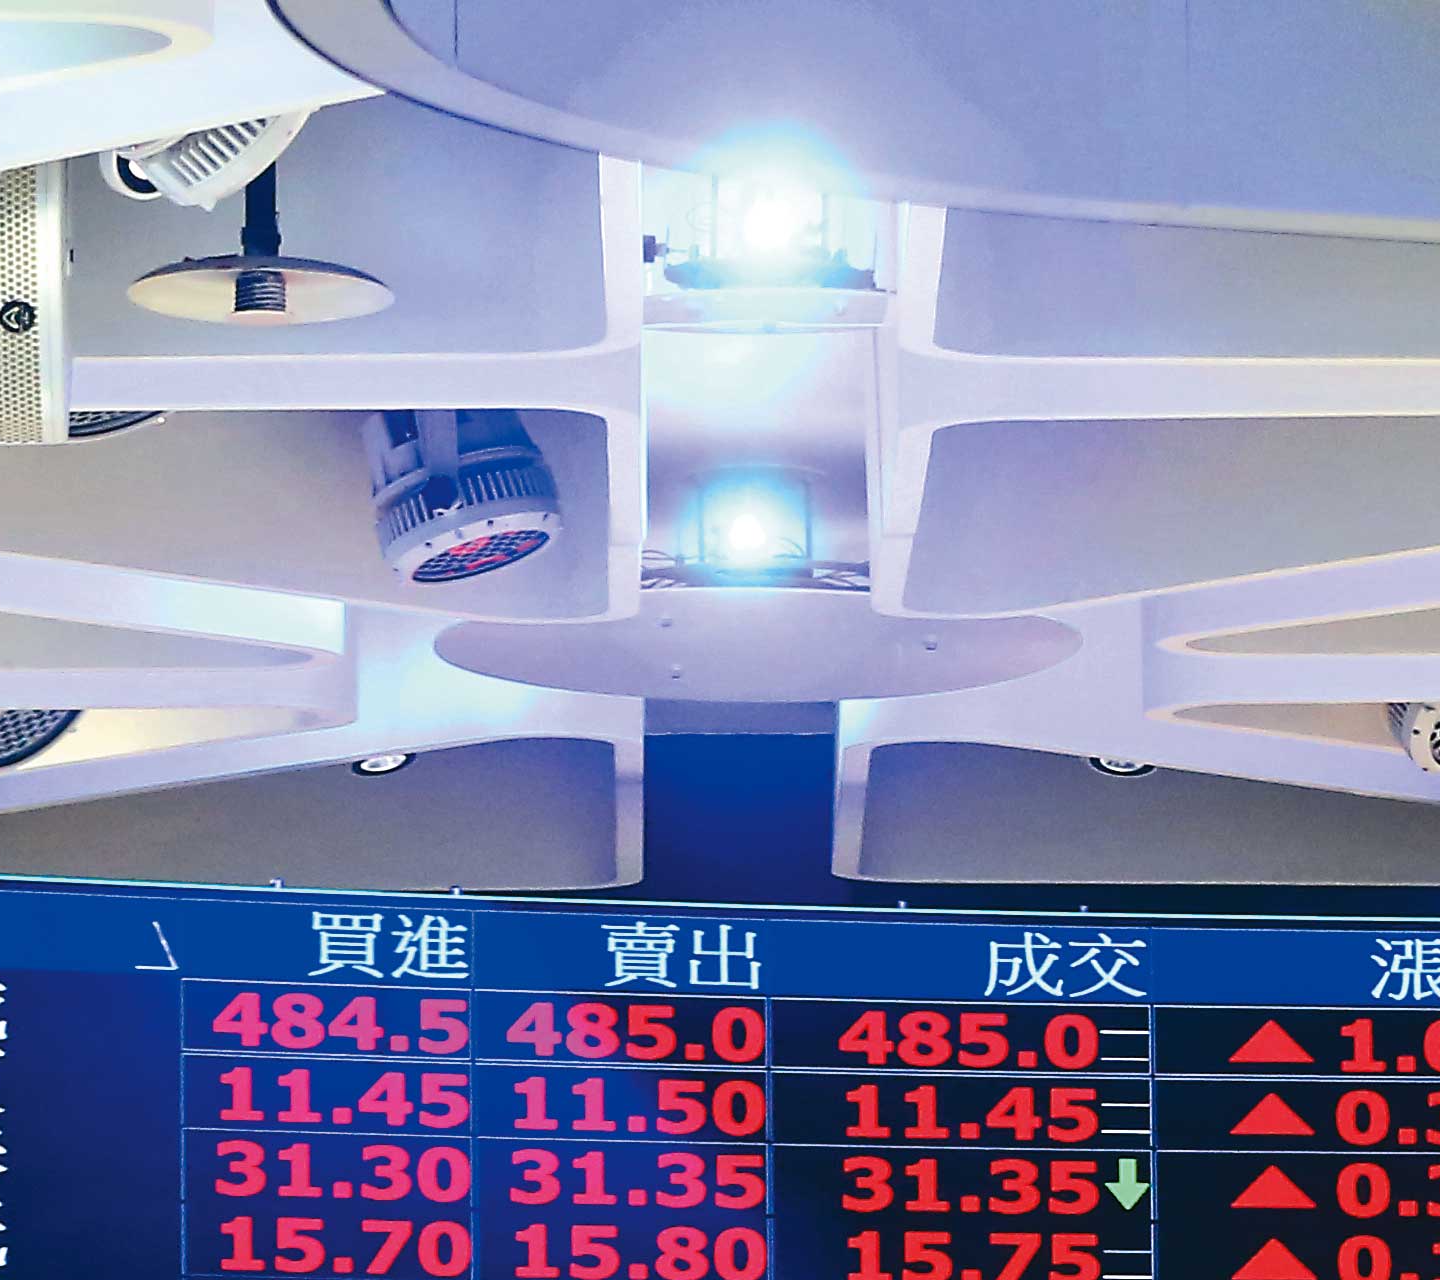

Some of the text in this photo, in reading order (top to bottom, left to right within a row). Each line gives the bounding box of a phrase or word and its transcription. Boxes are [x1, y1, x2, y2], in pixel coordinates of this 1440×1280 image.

[310, 911, 470, 978] 買進
[605, 923, 762, 988] 賣出
[984, 932, 1147, 997] 成交
[213, 993, 468, 1053] 484.5
[507, 1003, 766, 1062] 485.0
[839, 1011, 1098, 1069] 485.0
